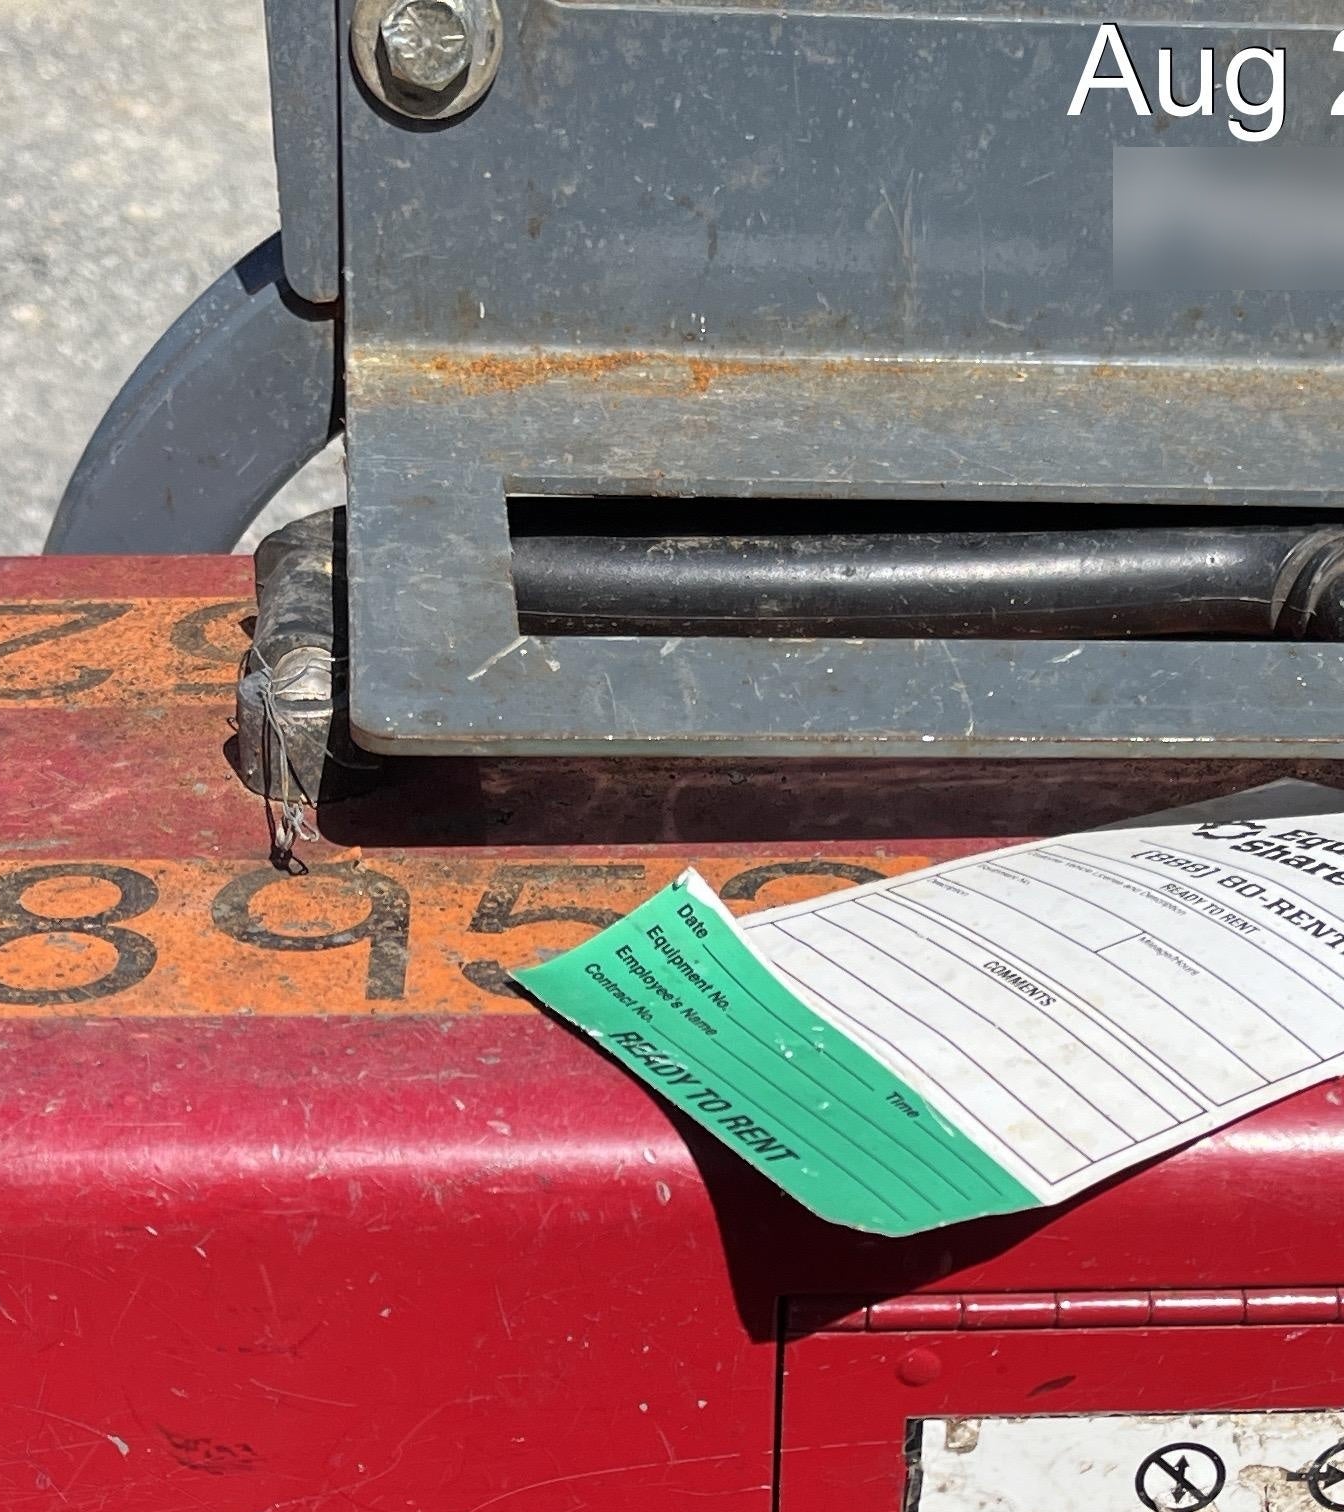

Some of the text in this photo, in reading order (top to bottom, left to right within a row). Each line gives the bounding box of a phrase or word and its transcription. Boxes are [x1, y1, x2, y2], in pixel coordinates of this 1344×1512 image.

[1130, 849, 1222, 879] (888)
[1159, 882, 1262, 936] READY TO RENT
[584, 962, 654, 1024] Contract No.
[614, 944, 719, 1037] Employee's Name
[646, 924, 730, 1012] Equipment No.
[982, 960, 1057, 1008] COMMENTS
[675, 902, 921, 1120] Date Time
[608, 1030, 802, 1166] READY TO RENT
